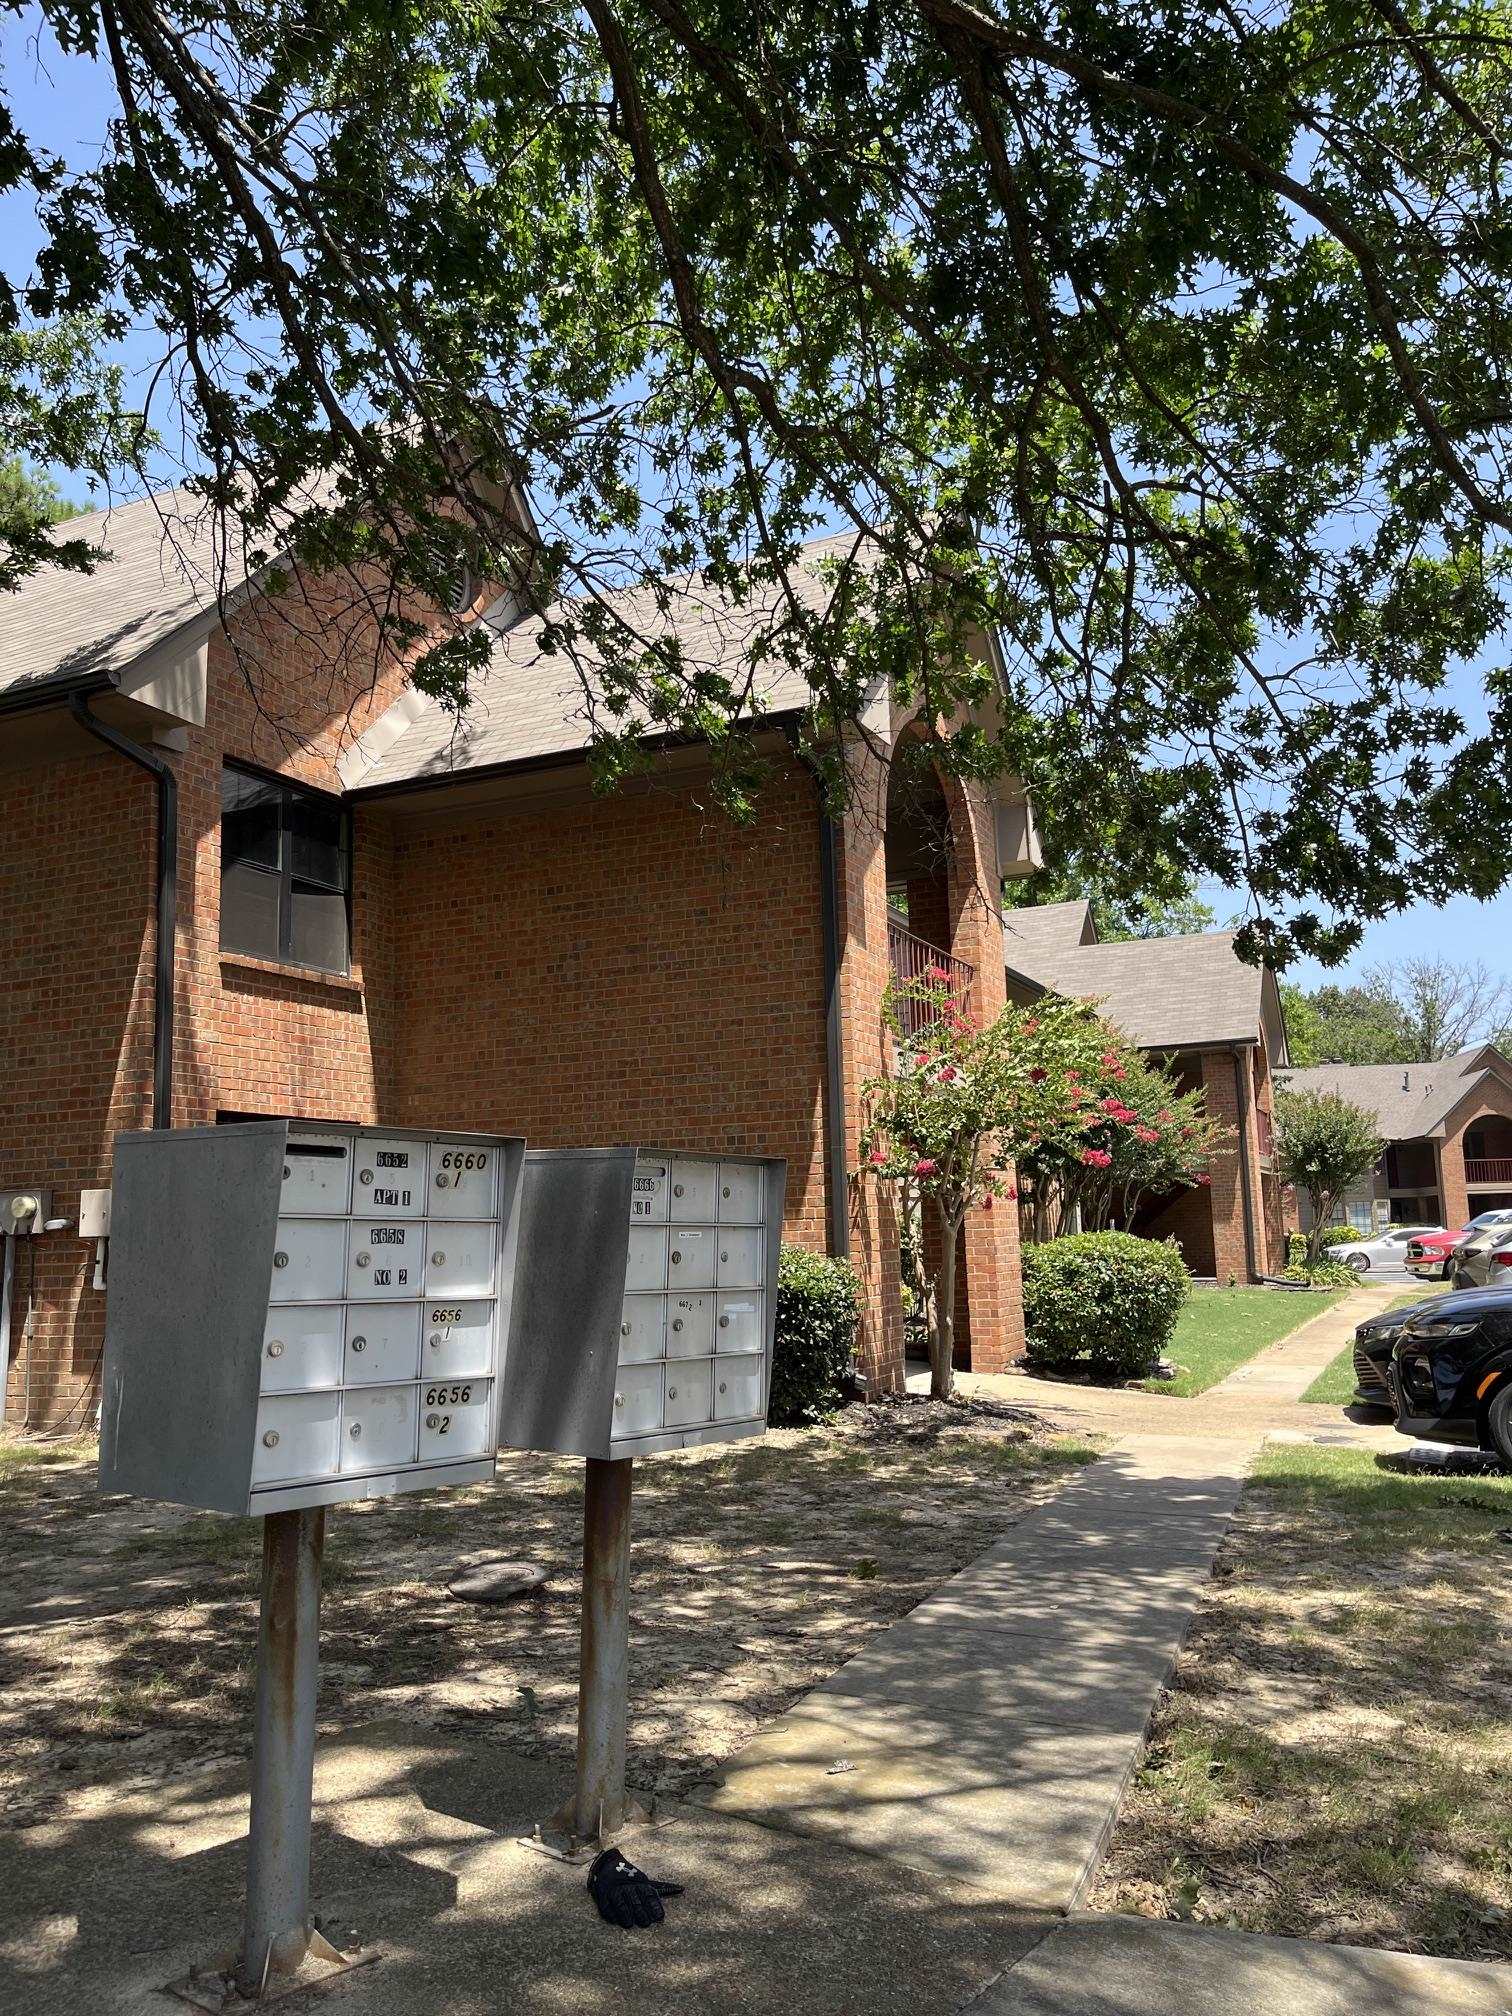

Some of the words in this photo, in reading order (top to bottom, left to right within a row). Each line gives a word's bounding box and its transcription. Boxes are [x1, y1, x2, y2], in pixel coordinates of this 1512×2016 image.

[377, 1152, 408, 1168] 6652
[442, 1152, 487, 1170] 6660
[454, 1171, 462, 1188] 1
[374, 1189, 398, 1205] APT
[403, 1191, 410, 1206] 1
[375, 1269, 391, 1285] NO
[399, 1269, 407, 1284] 2
[432, 1309, 462, 1322] 6656
[426, 1385, 471, 1405] 6656
[439, 1416, 450, 1434] 2
